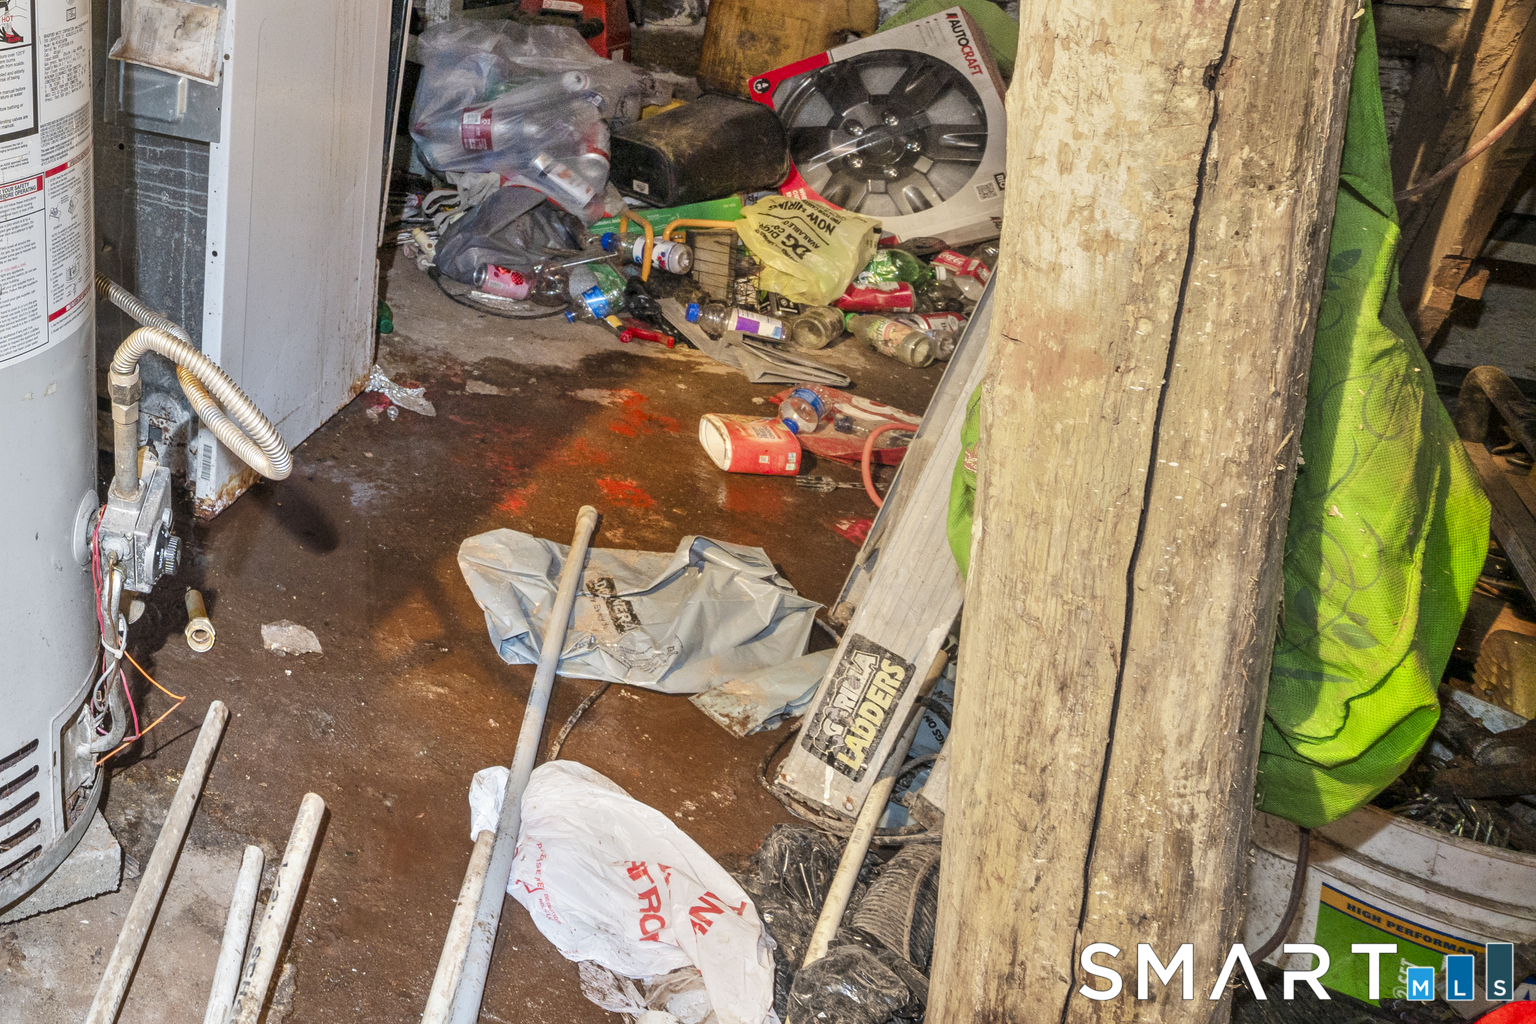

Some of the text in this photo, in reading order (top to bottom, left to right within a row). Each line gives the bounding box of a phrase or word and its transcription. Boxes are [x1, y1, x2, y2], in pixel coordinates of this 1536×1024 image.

[949, 20, 983, 76] AUTOCRAFT
[2, 186, 13, 194] YOUR
[15, 182, 29, 190] SAFETY
[15, 185, 36, 195] OPERATING
[787, 221, 821, 249] AVAILABLE
[806, 212, 836, 236] NOW
[781, 234, 812, 260] DG
[837, 659, 906, 771] LADDERS
[1346, 902, 1381, 923] HIGH
